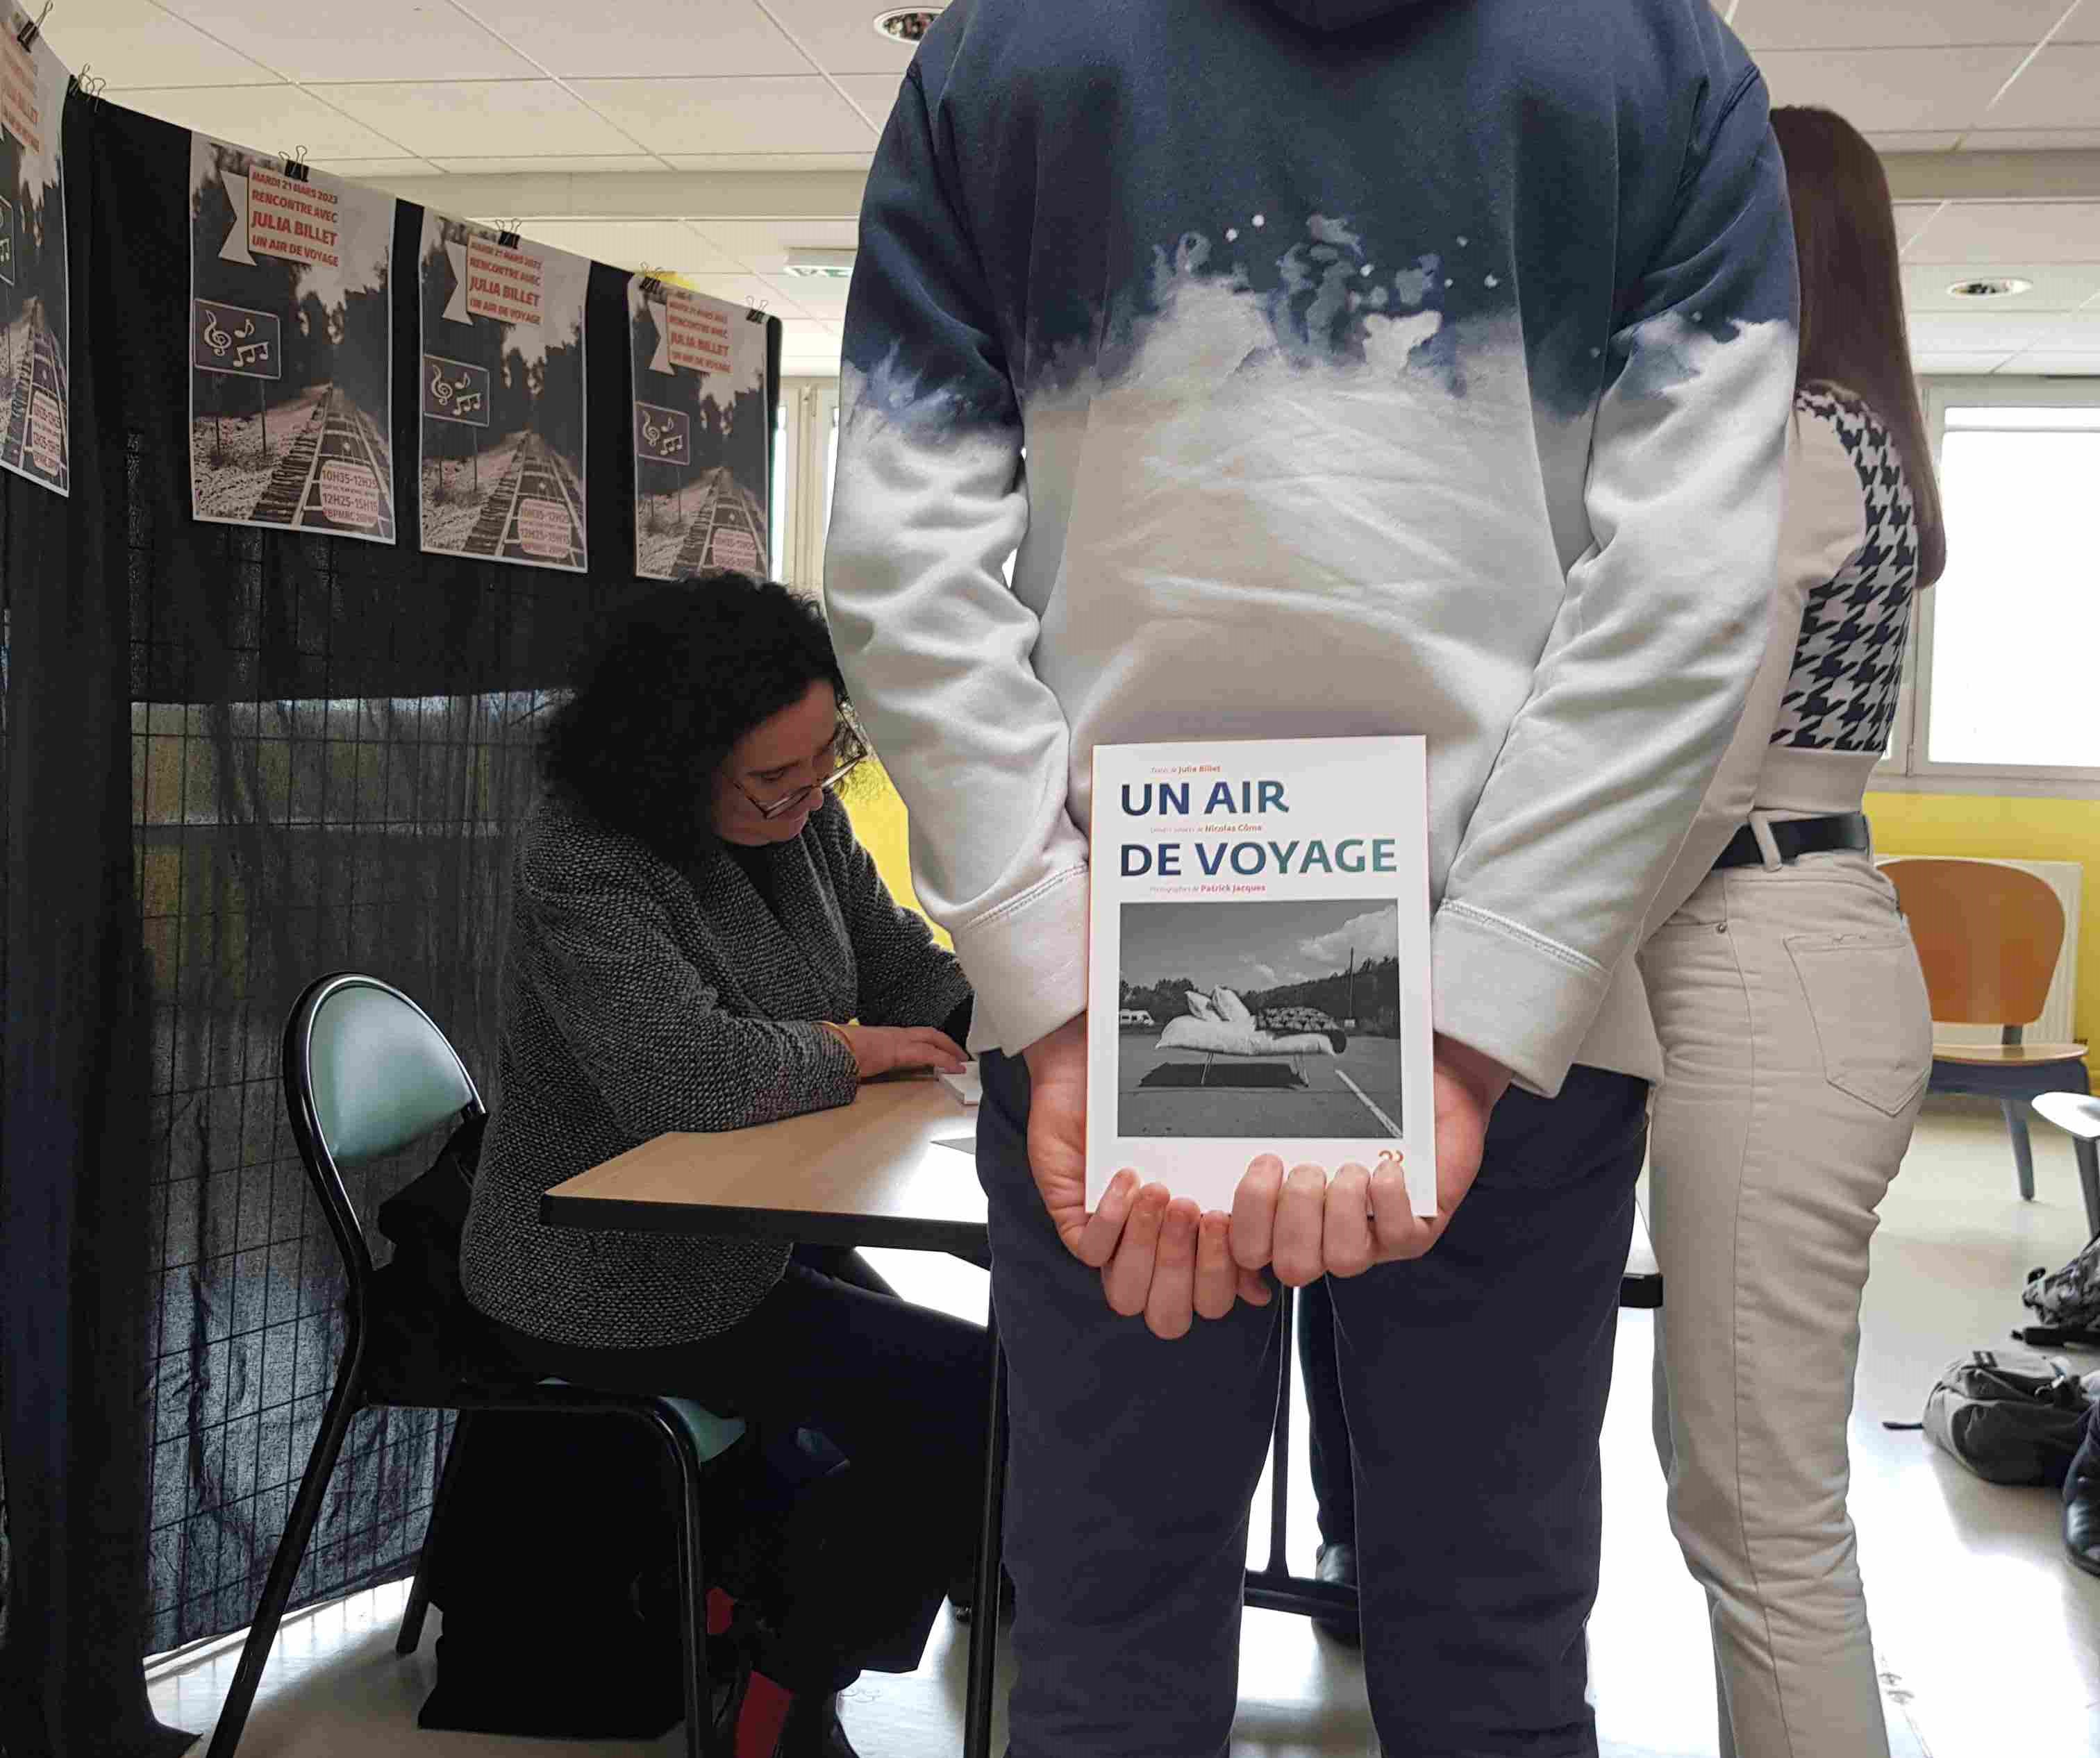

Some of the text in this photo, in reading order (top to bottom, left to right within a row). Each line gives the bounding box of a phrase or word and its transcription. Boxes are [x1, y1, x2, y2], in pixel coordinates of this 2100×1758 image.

[252, 172, 338, 204] MARDI 21 MARS 2023
[251, 190, 339, 223] RENCONTRE AVEC
[251, 211, 339, 246] JULIA BILLET
[252, 235, 339, 267] UN AIR DE VOYAGE
[469, 276, 541, 307] JULIA BILLET
[510, 308, 541, 325] VOYAGE
[671, 332, 729, 356] JULIA BILLET
[1178, 765, 1197, 774] Julia
[1122, 780, 1290, 816] UN AIR
[1205, 824, 1236, 832] Nicolas
[1121, 839, 1397, 876] DE VOYAGE
[1200, 884, 1231, 893] Patrick
[1233, 884, 1267, 894] Jacques
